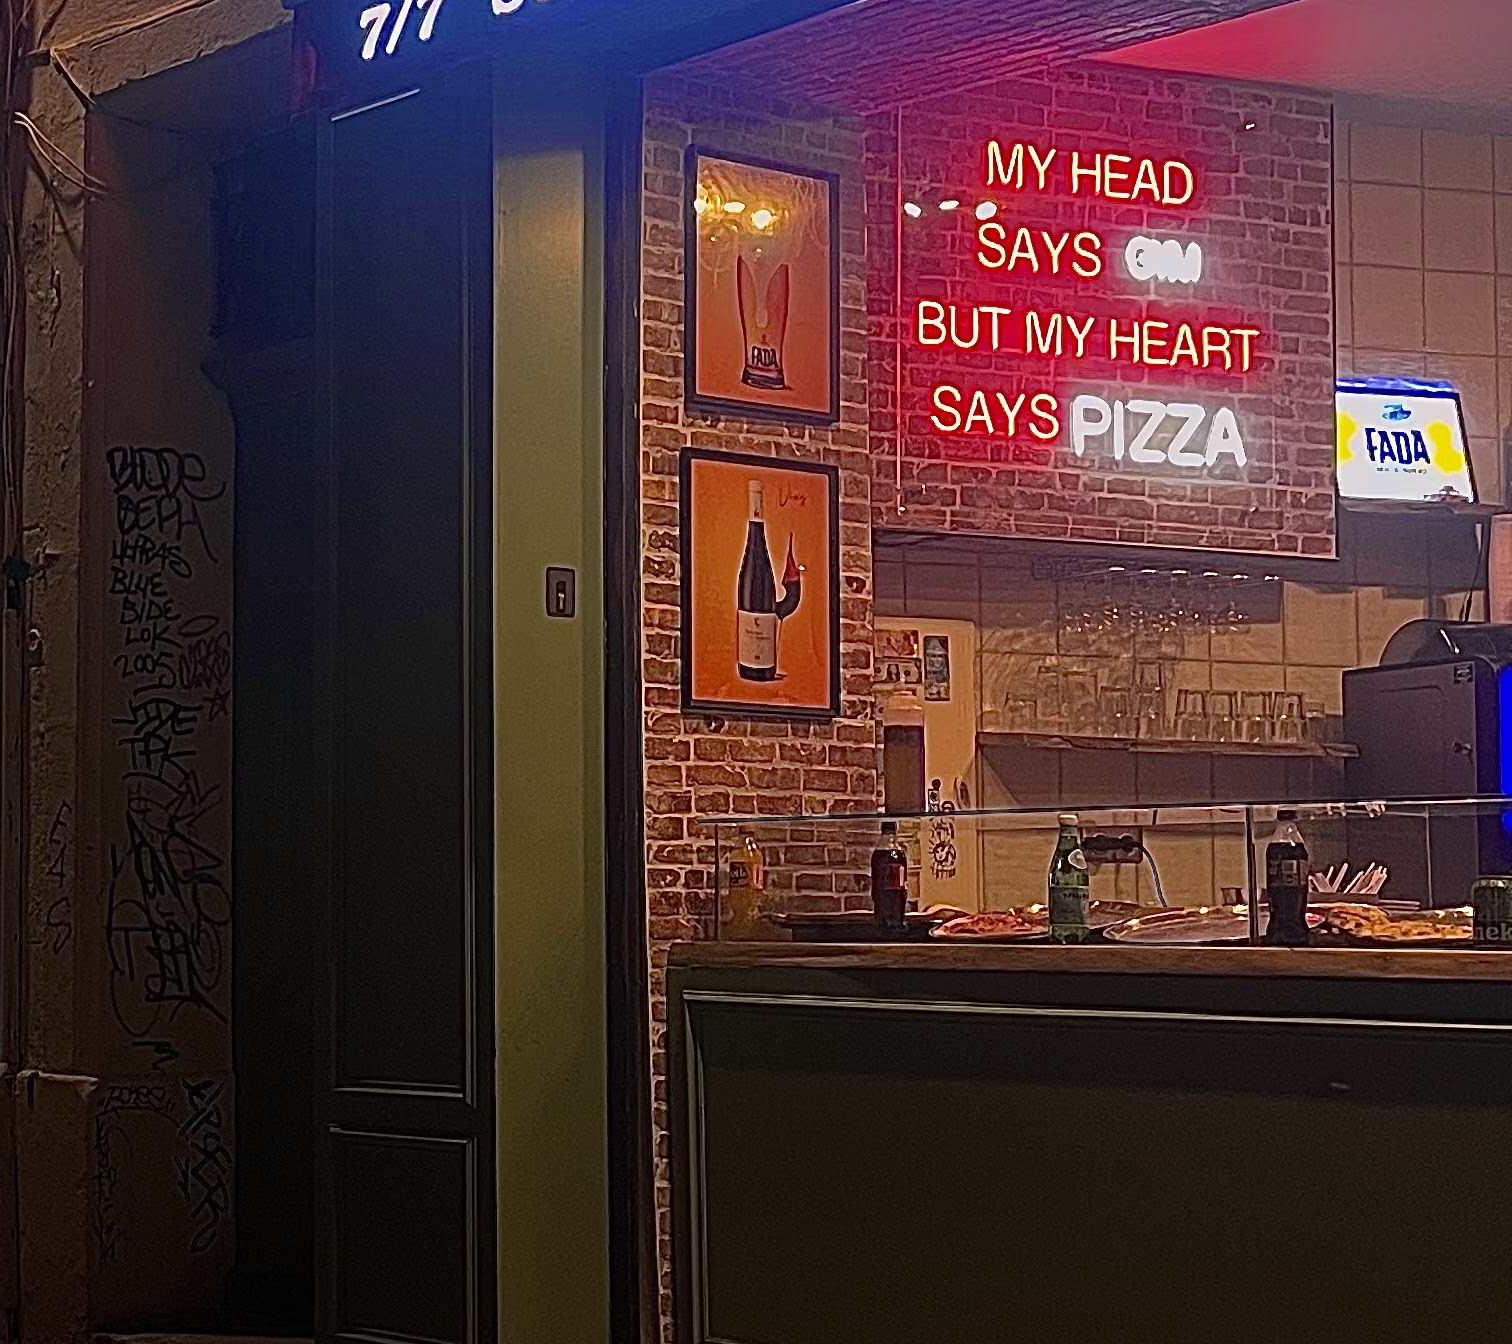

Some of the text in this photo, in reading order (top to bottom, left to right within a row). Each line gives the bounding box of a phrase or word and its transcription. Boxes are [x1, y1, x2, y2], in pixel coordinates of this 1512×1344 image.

[986, 140, 1194, 206] MY HEAD
[977, 222, 1102, 277] SAYS
[918, 299, 1260, 372] BUT MY HEART
[931, 385, 1246, 467] SAYS PIZZA
[1365, 428, 1430, 465] FADA
